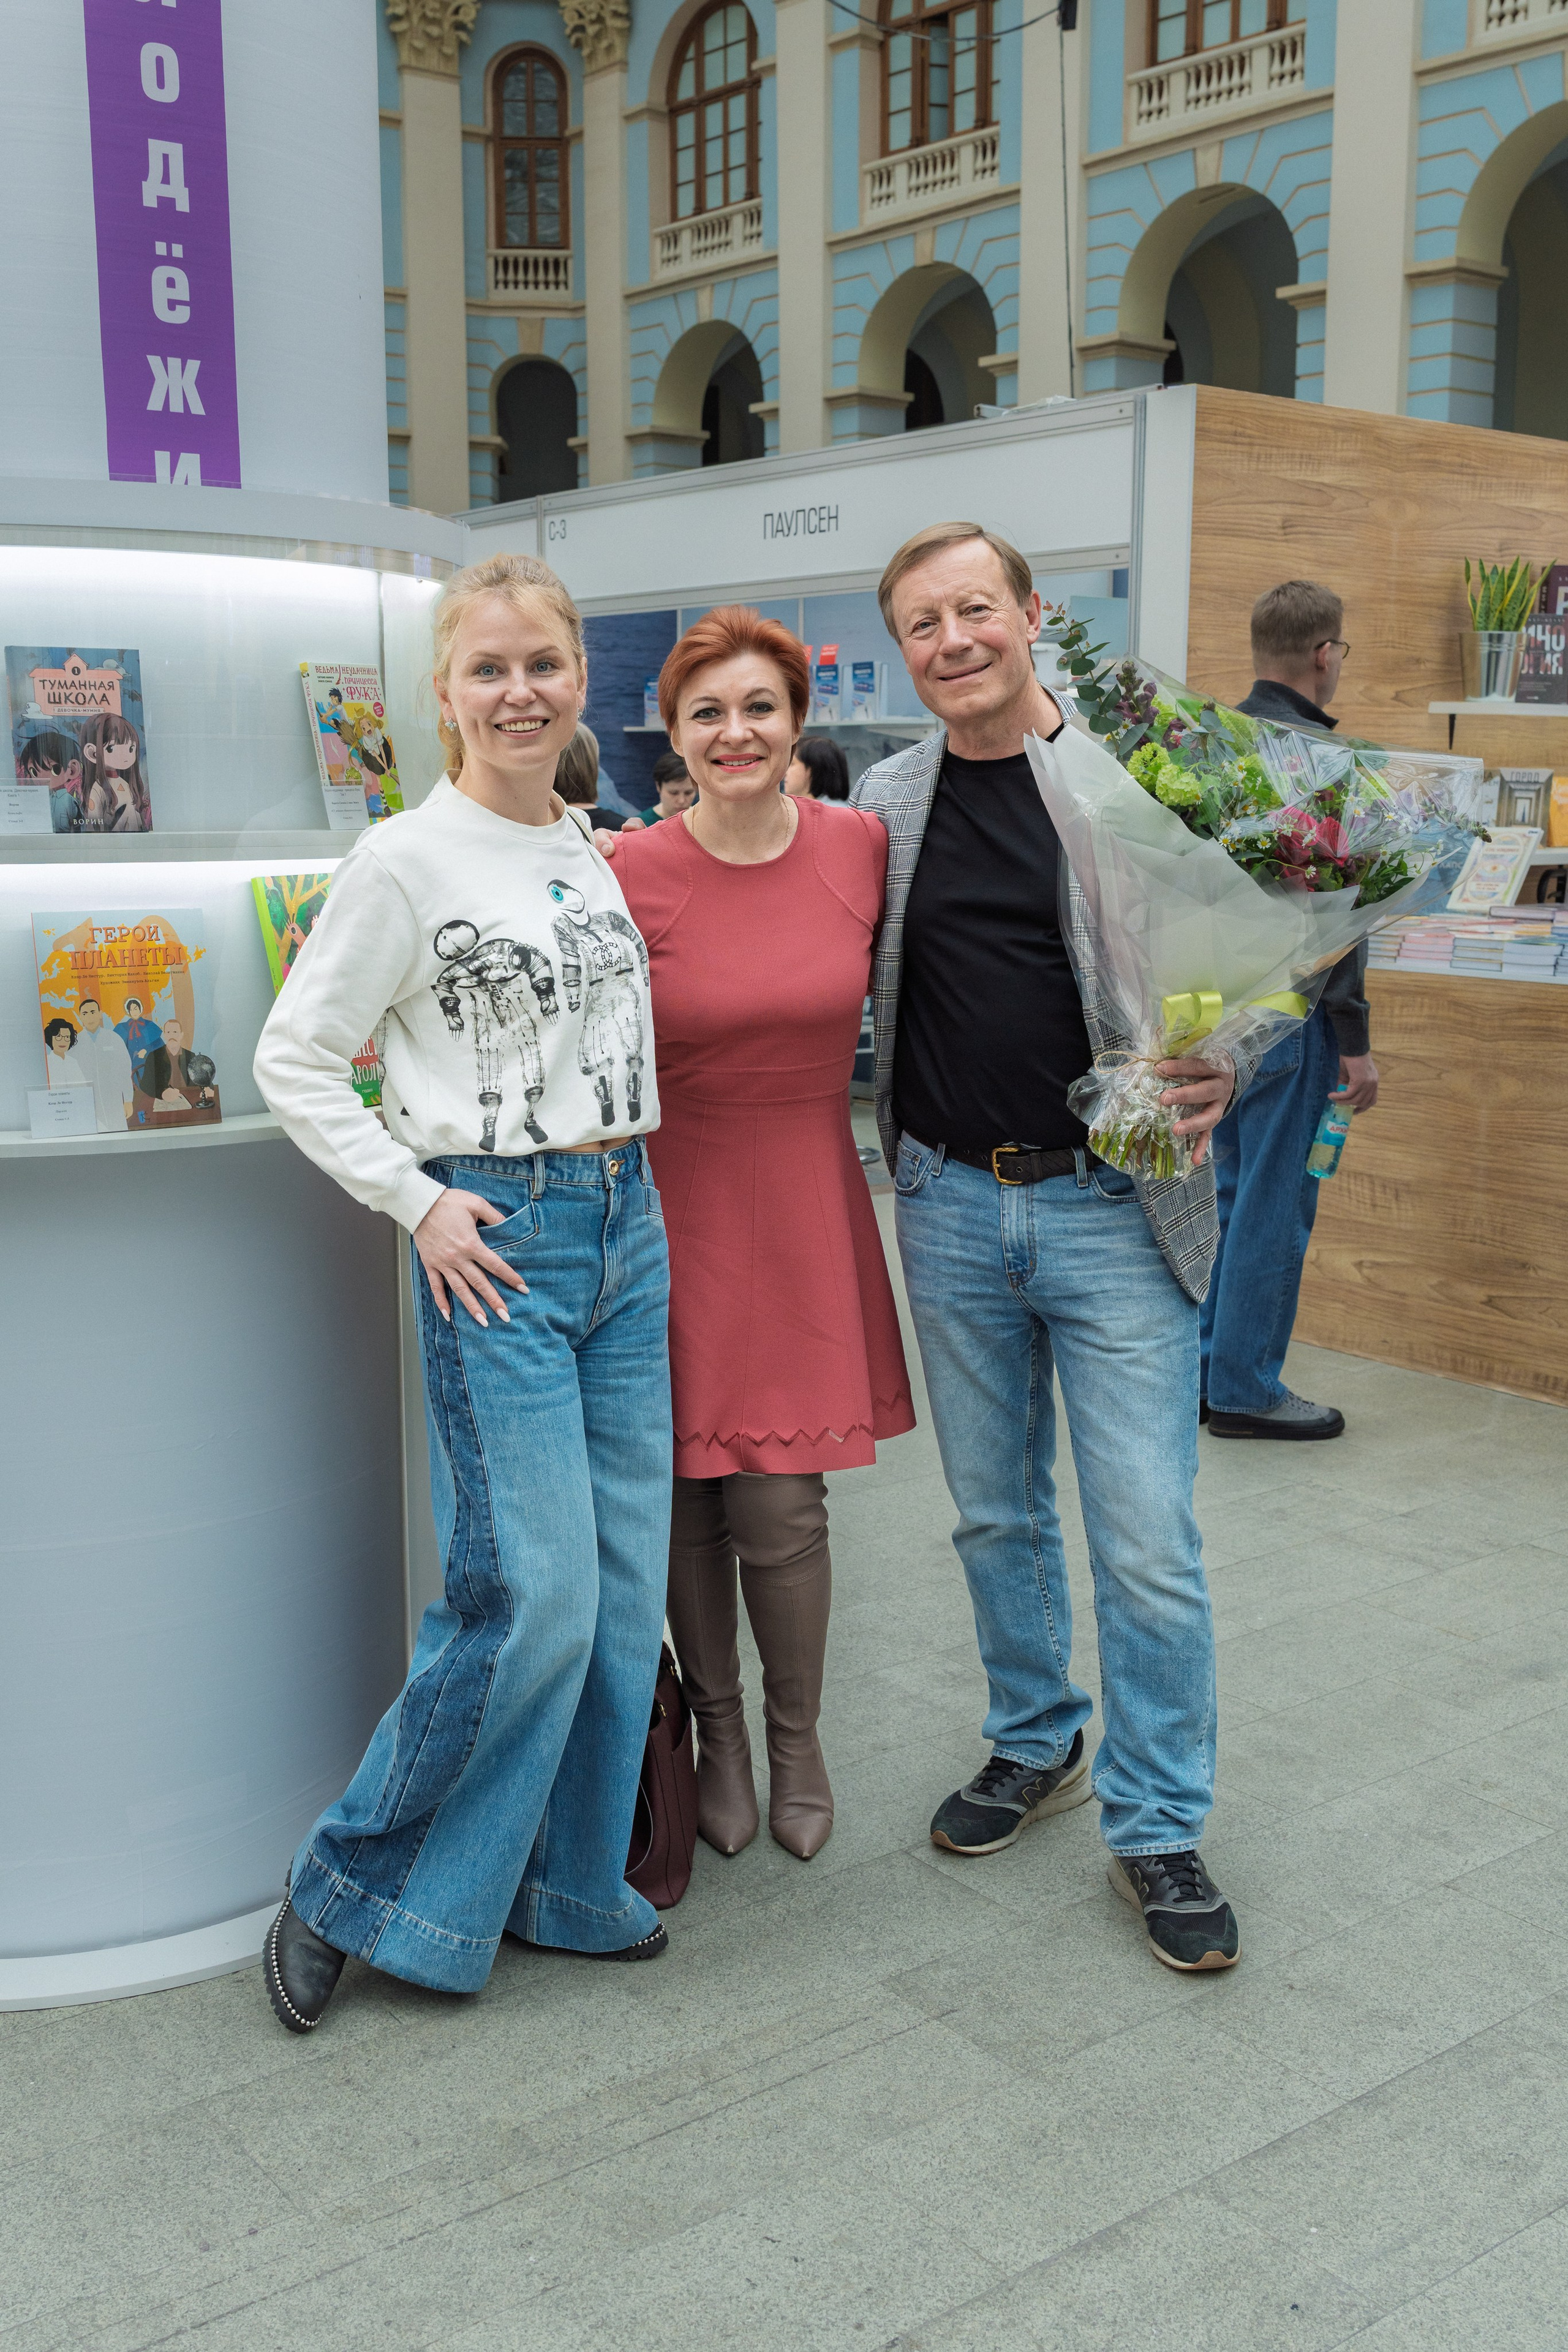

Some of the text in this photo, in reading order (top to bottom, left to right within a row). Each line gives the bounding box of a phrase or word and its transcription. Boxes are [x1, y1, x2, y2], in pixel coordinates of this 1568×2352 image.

[135, 0, 206, 486] одёжи
[548, 519, 567, 540] С-3
[764, 505, 839, 540] ПАУЛСЕН
[315, 665, 378, 676] ВЕДЬМА НЕУДАЧНИЦА
[39, 679, 115, 691] ТУМАННАЯ
[346, 686, 380, 701] ФУКА
[47, 692, 111, 706] ШКОЛА
[89, 925, 160, 944] ГЕРОИ
[69, 947, 184, 970] ПЛАНЕТЫ
